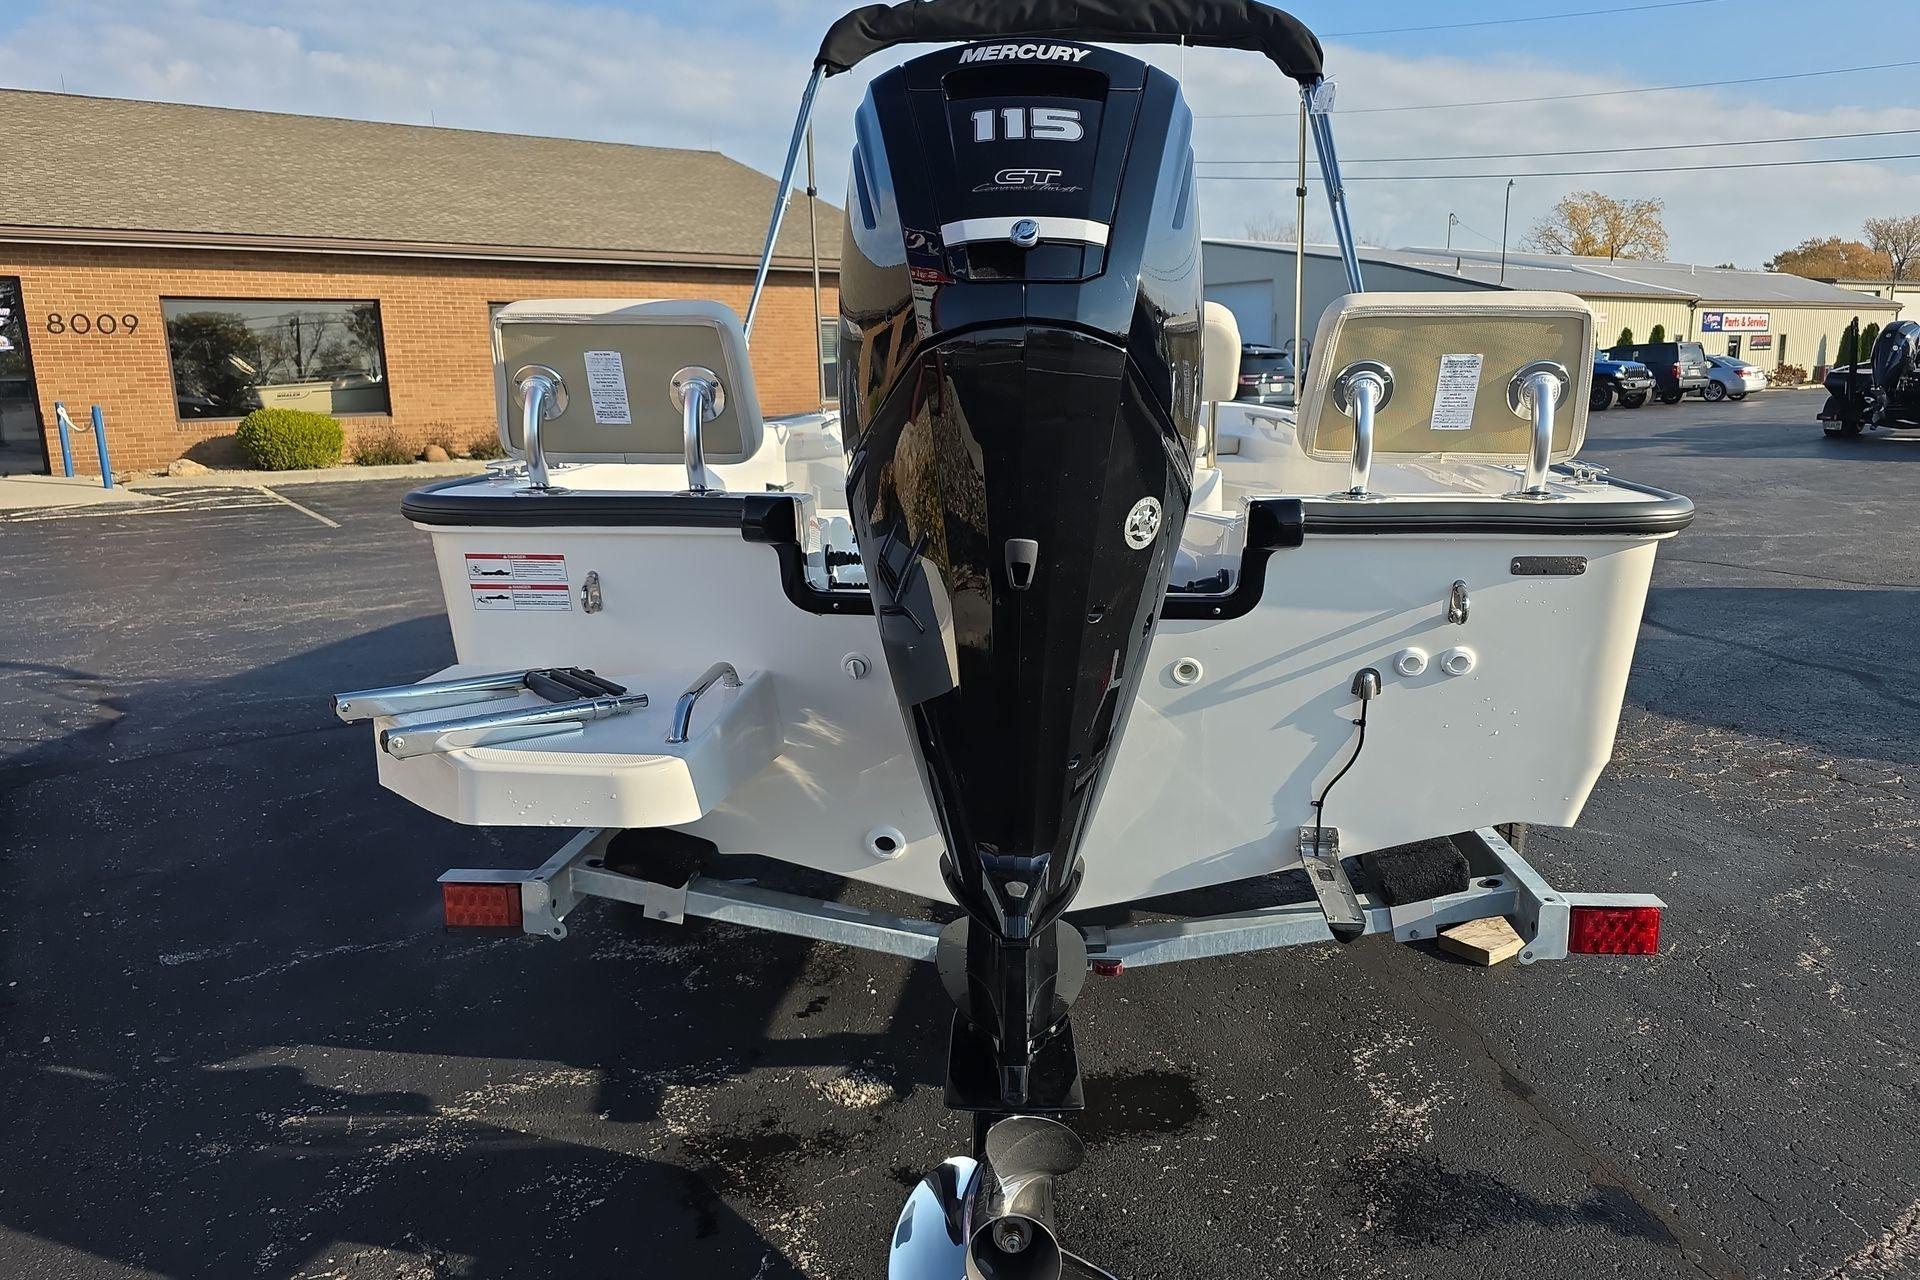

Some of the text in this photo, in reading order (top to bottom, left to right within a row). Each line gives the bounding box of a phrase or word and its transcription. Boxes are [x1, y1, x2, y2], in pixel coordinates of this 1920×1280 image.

[958, 44, 1092, 64] MERCURY
[971, 107, 1084, 142] 115
[46, 313, 139, 335] 8009
[1724, 316, 1740, 327] Parts
[1741, 316, 1746, 327] &
[1747, 316, 1767, 327] Service
